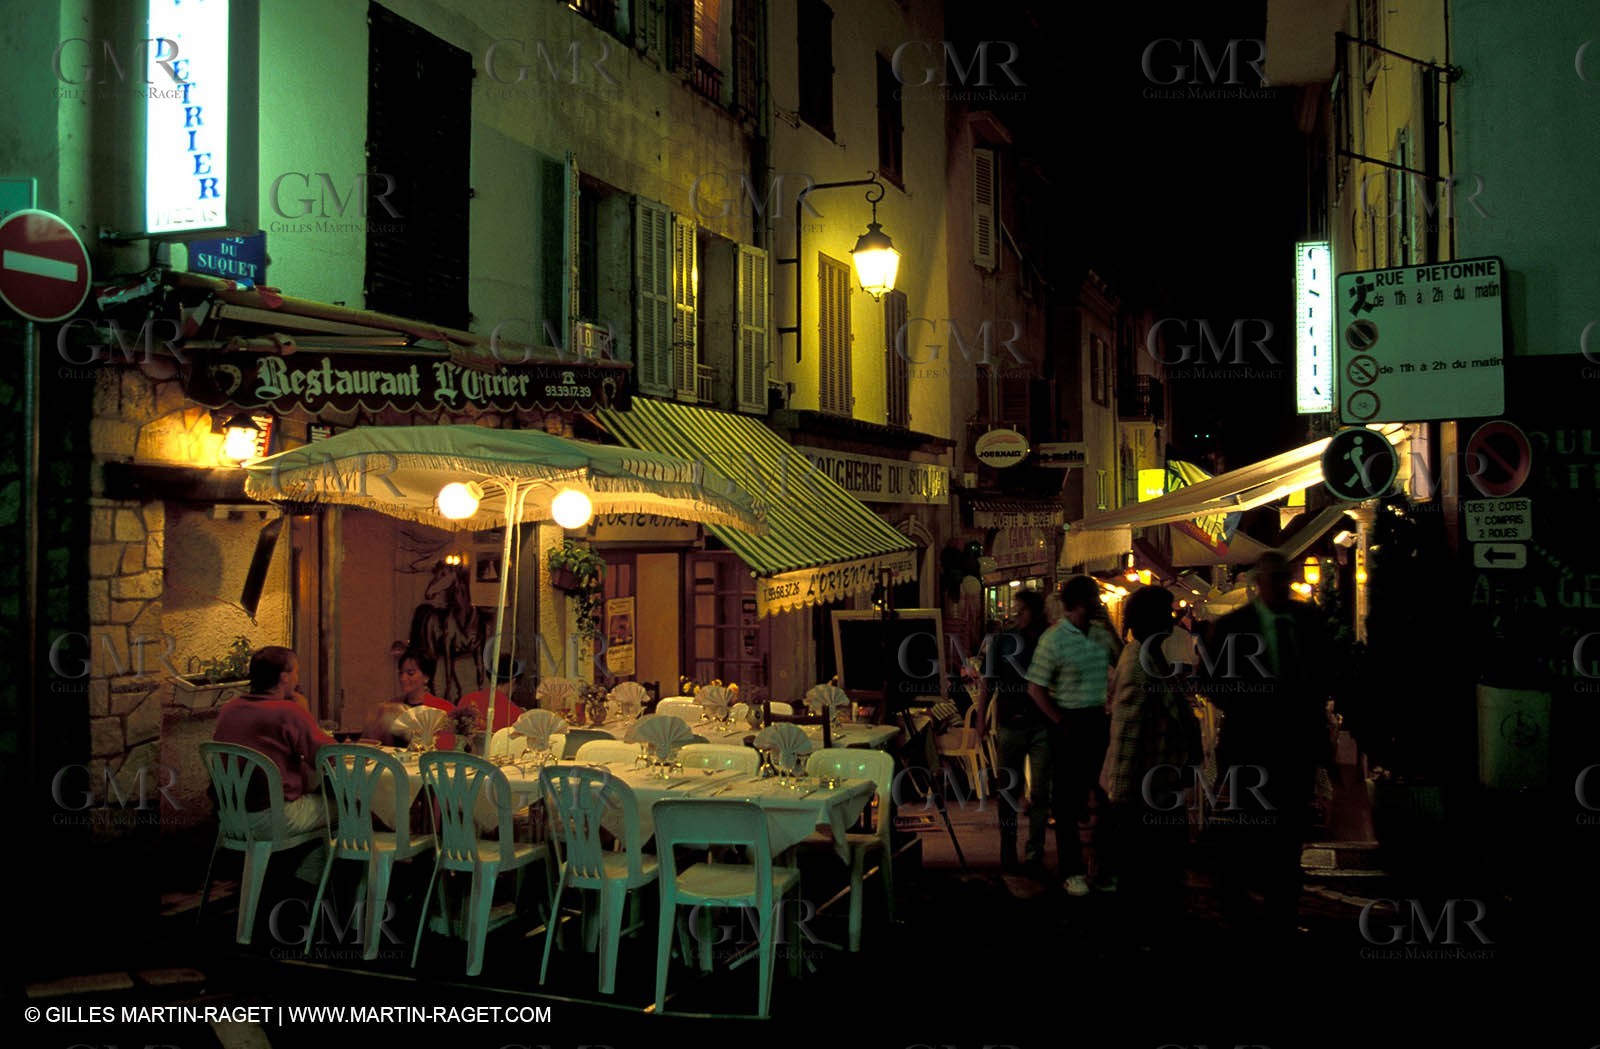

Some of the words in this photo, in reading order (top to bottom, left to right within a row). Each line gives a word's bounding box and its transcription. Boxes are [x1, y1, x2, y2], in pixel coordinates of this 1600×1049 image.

[221, 243, 237, 257] DU
[197, 253, 257, 278] SUQUET
[1376, 271, 1404, 287] RUE
[1416, 261, 1496, 282] PIETONNE
[1432, 287, 1443, 302] 2h
[1454, 284, 1464, 300] du
[1475, 282, 1499, 299] matin
[1380, 365, 1393, 374] de
[1433, 361, 1446, 370] 2h
[1452, 359, 1466, 368] du
[1472, 357, 1503, 368] matin
[256, 356, 420, 402] Restaurant
[805, 454, 882, 493] OUCHERIE
[888, 466, 904, 494] DU
[1468, 502, 1485, 512] DES
[1489, 502, 1494, 512] 2
[1479, 529, 1485, 538] 2
